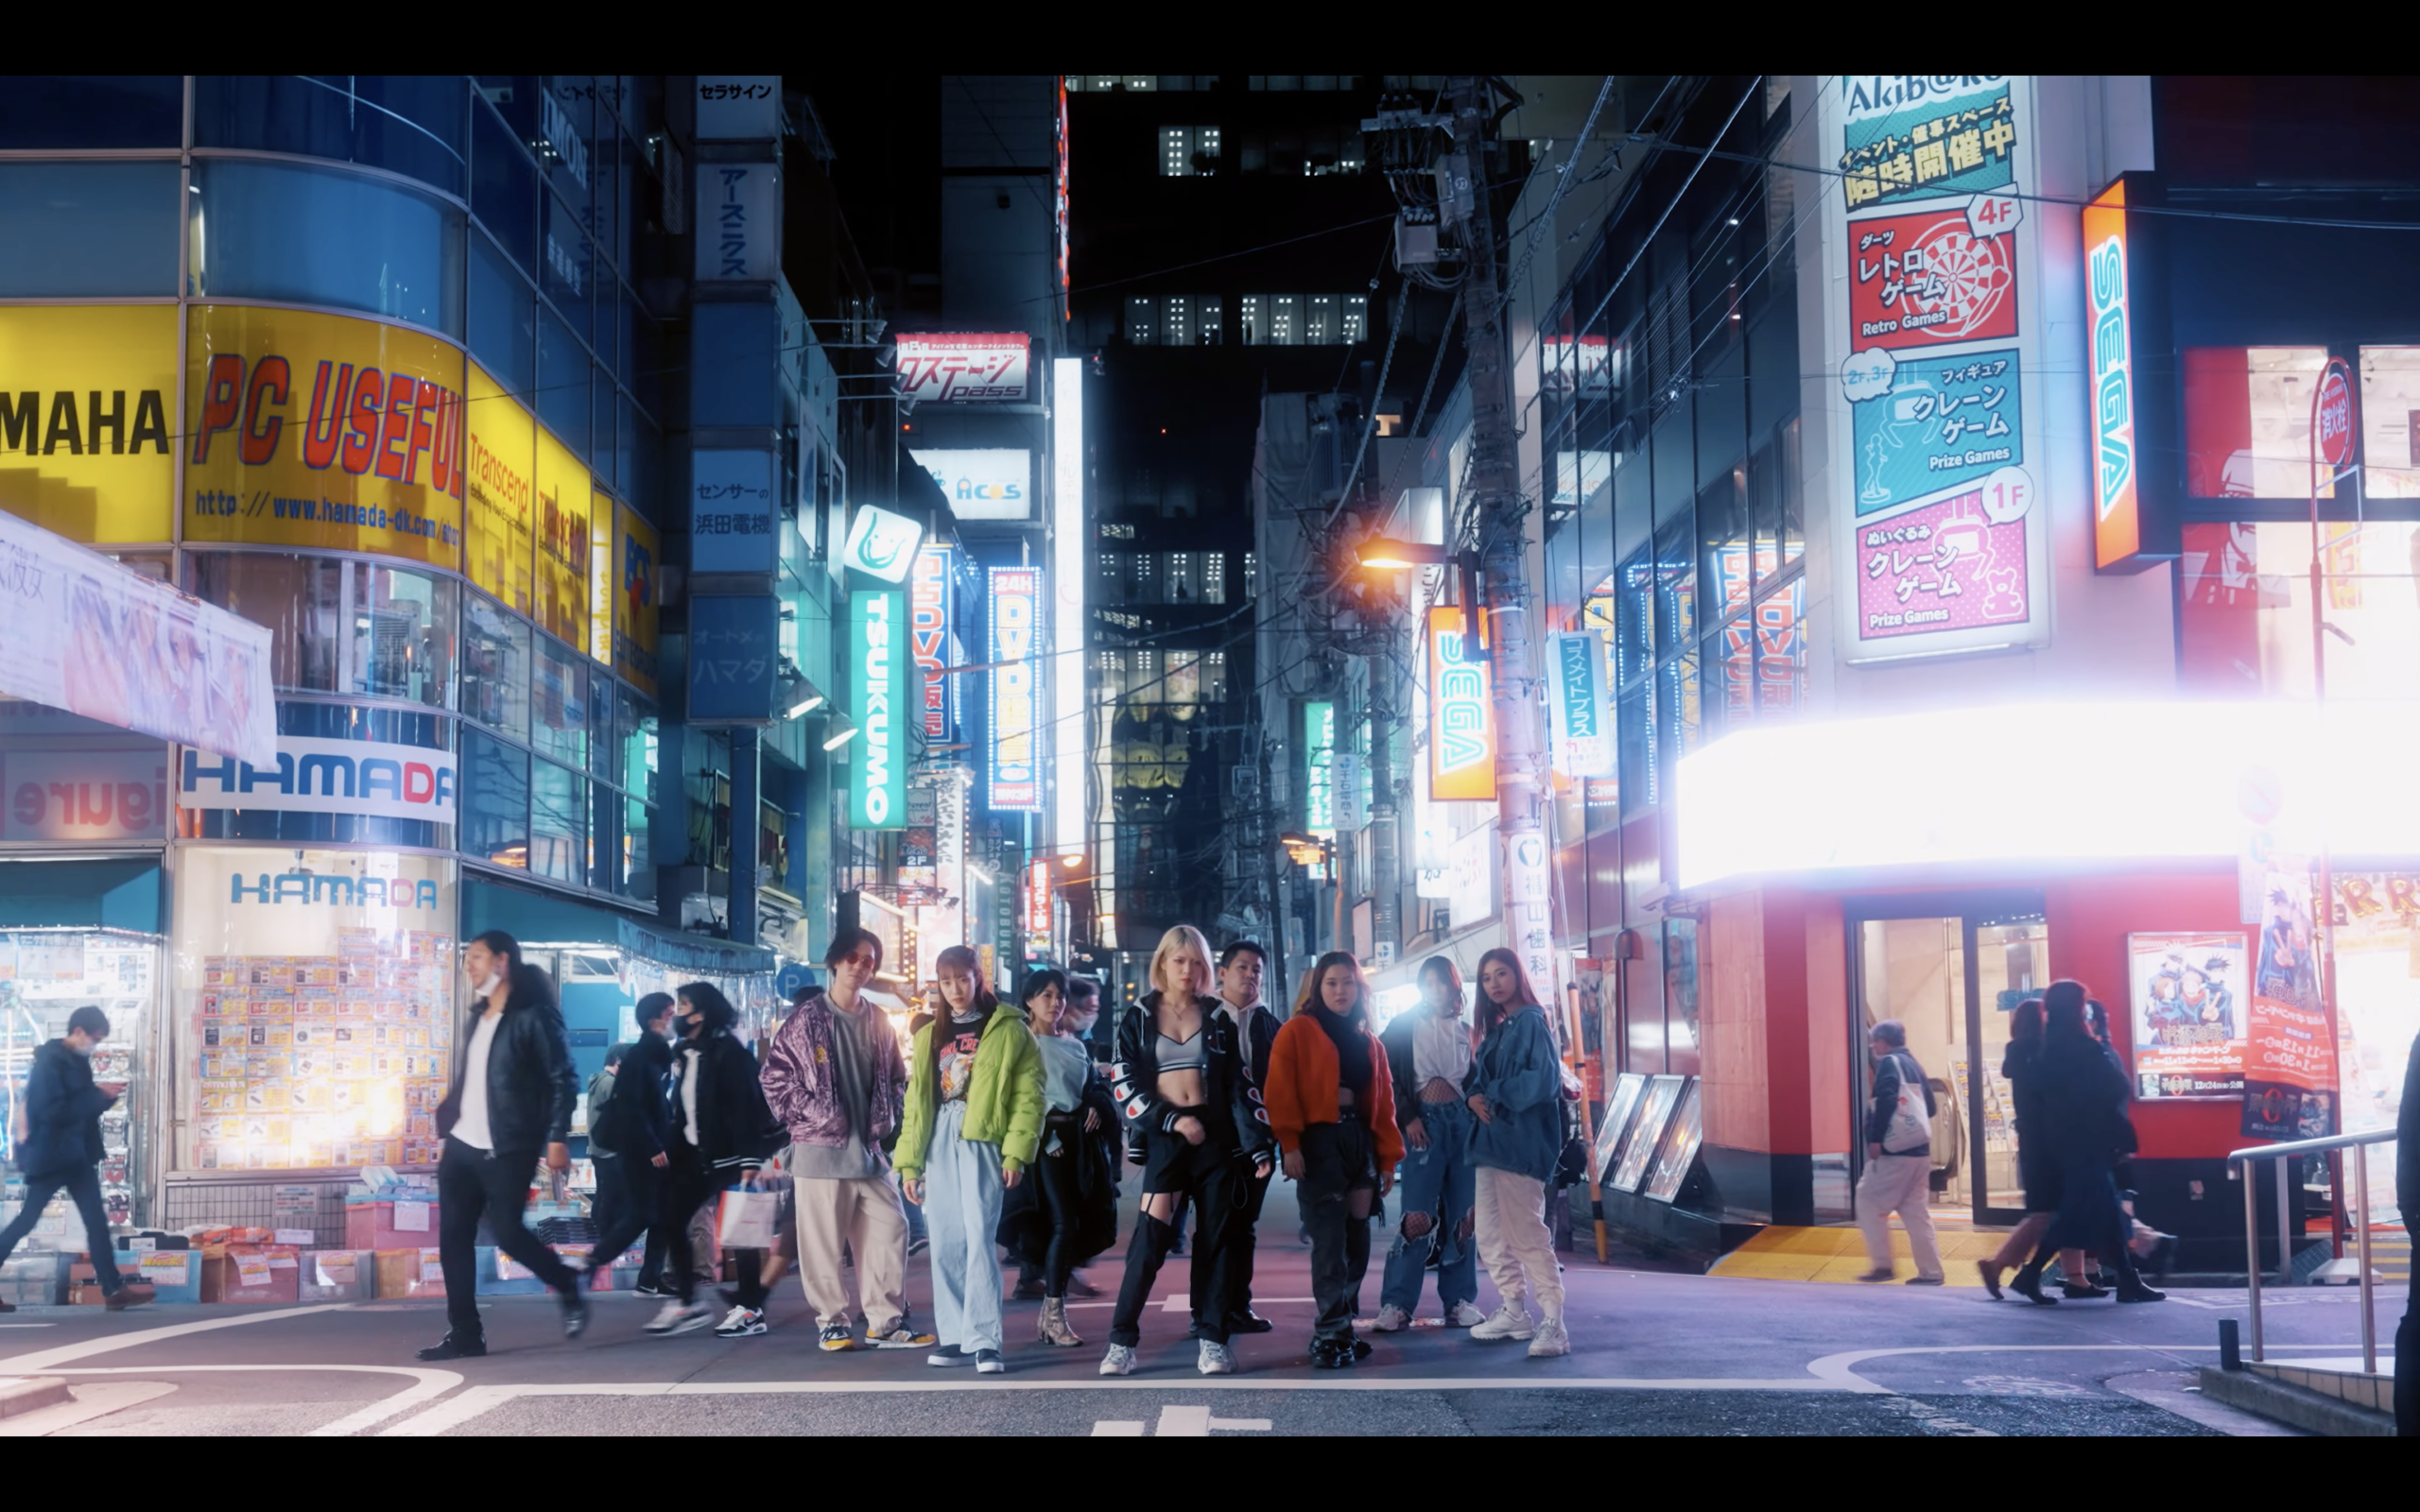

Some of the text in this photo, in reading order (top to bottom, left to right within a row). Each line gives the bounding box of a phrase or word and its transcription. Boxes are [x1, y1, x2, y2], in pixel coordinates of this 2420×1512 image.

[700, 84, 772, 100] セラサイン
[1844, 119, 2015, 210] 随時開催中
[718, 169, 748, 276] アースニクス
[1978, 198, 2013, 225] 4F
[1859, 231, 1895, 250] ダーツ
[1858, 249, 1925, 283] レトロ
[1880, 272, 1946, 305] ゲーム
[1862, 310, 1946, 336] Retro Games
[1942, 360, 2007, 384] フィギュア
[2088, 233, 2133, 523] SEGA
[1914, 385, 2006, 421] クレーン
[2322, 398, 2347, 441] 消火栓
[192, 353, 461, 501] PC USEFUL
[1943, 412, 2011, 445] ゲーム
[471, 433, 528, 514] Transcend
[1929, 447, 2010, 471] Prize Games
[697, 483, 769, 500] センサーの
[1992, 482, 2024, 509] 1F
[695, 513, 772, 536] 浜田電機
[1865, 524, 1932, 547] ぬいぐるみ
[1867, 543, 1960, 578] クレーン
[994, 576, 1034, 592] 24H
[1895, 575, 1963, 604] ゲーム
[1870, 608, 1949, 628] Prize Games
[694, 654, 768, 685] ハマダ
[1437, 630, 1489, 776] SEGA
[1565, 638, 1593, 737] コスメイトプラス
[866, 593, 889, 825] TSUKUMO
[183, 749, 456, 806] HAMADA
[908, 855, 927, 866] 2F
[232, 872, 437, 910] HAMADA
[1525, 874, 1548, 976] 福山歯科
[785, 974, 800, 1000] P
